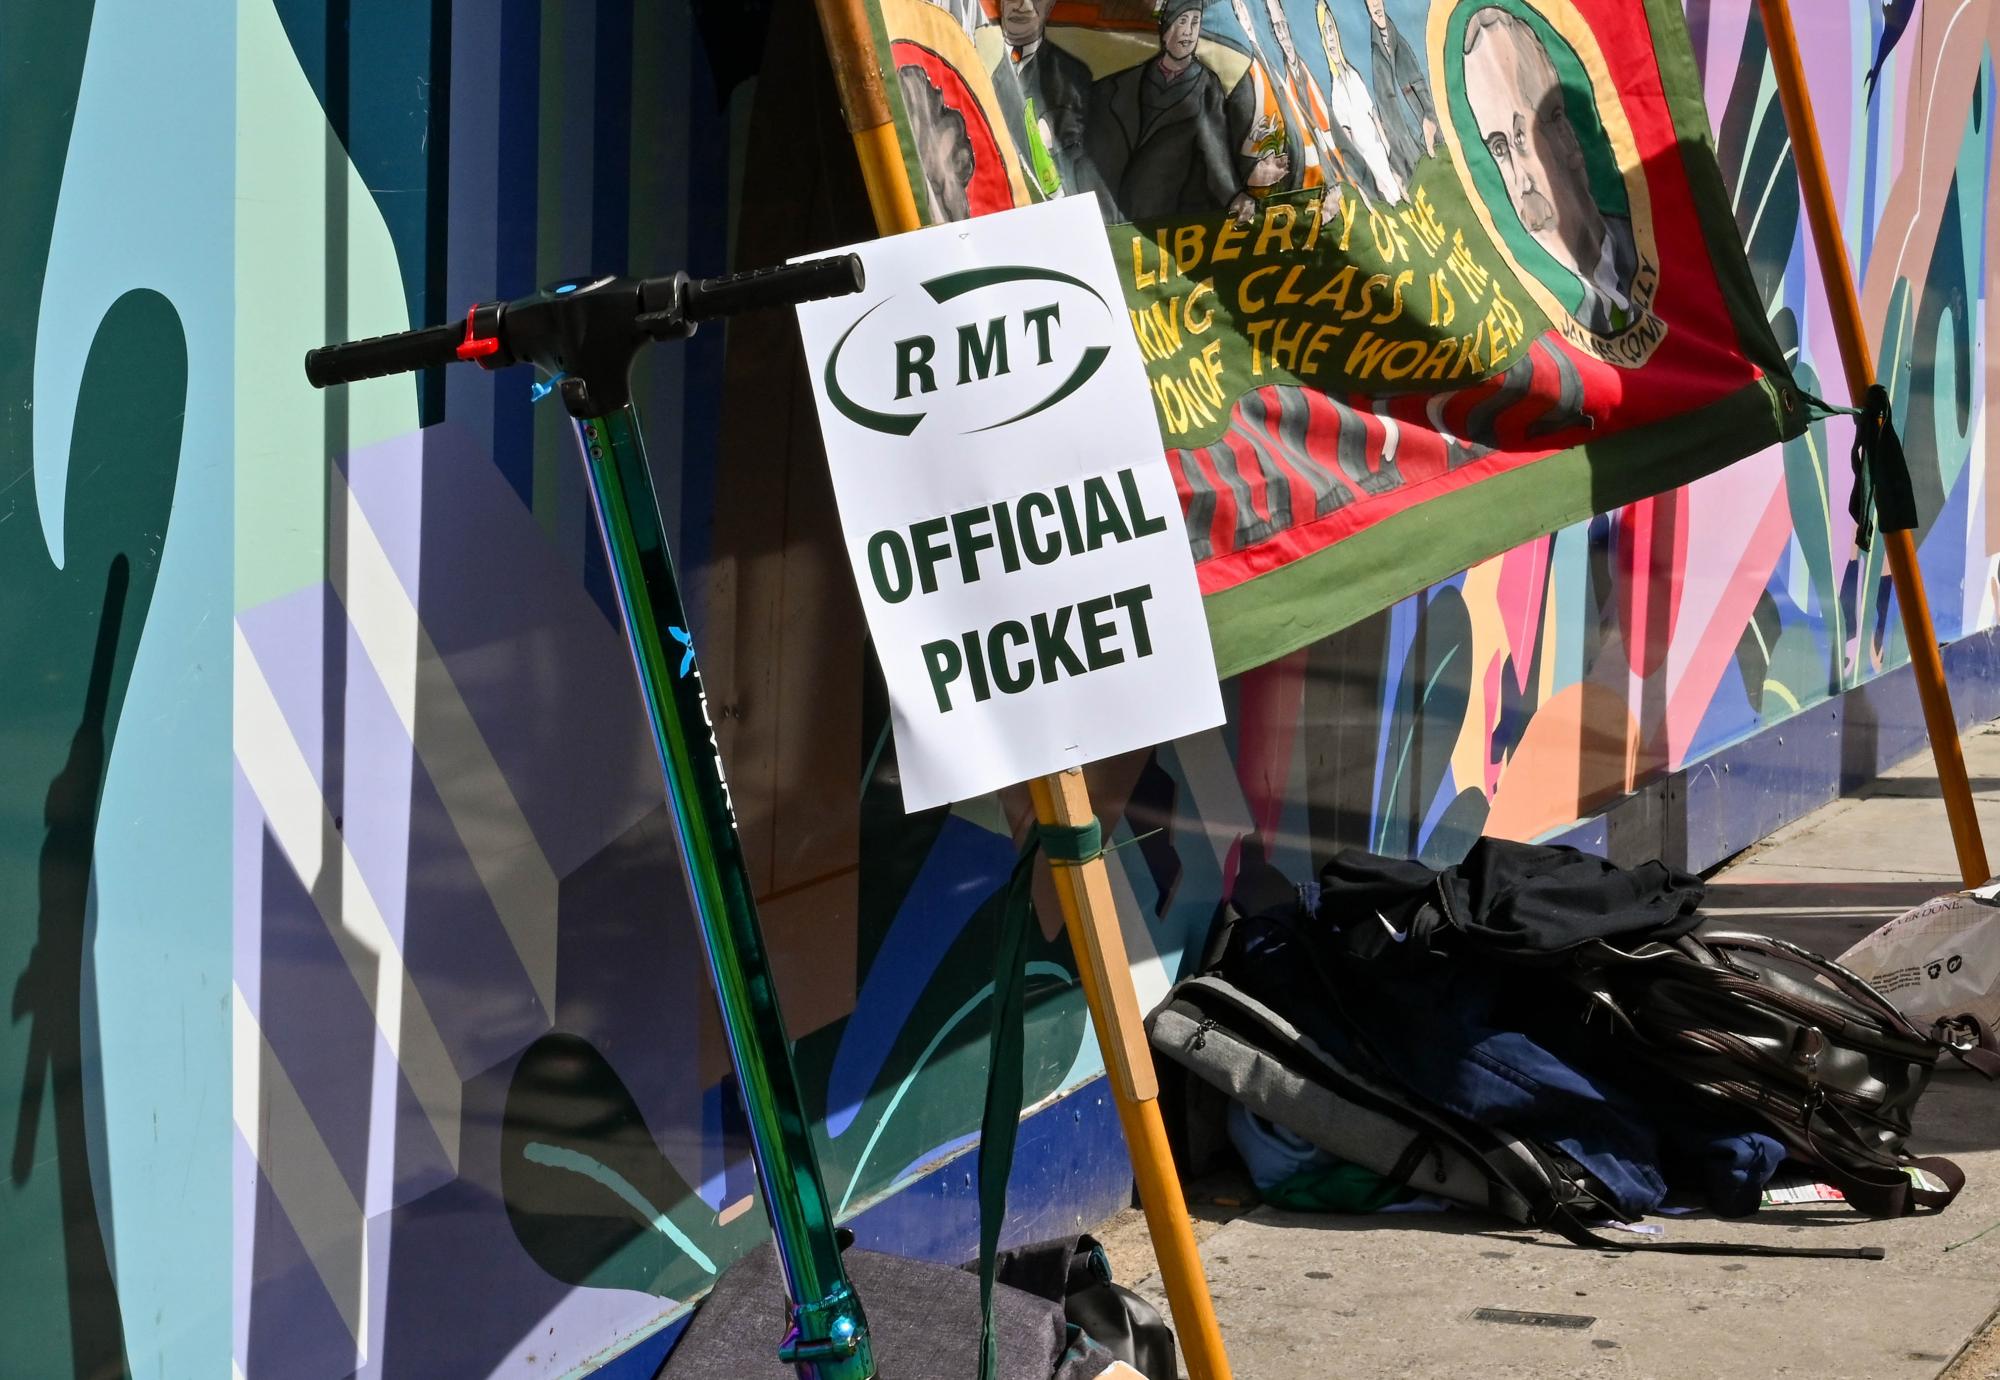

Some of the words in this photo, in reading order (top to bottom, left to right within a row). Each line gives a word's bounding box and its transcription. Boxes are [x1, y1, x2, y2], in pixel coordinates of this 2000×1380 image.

[1132, 194, 1357, 290] LIBERTY
[1369, 206, 1409, 263] OF
[1399, 184, 1446, 258] THE
[1129, 277, 1215, 366] KING
[1237, 264, 1414, 325] CLASS
[1429, 268, 1456, 327] IS
[1446, 228, 1490, 304] THE
[1246, 317, 1344, 377] THE
[1343, 279, 1525, 382] WORKERS
[1560, 311, 1625, 365] JAMES
[892, 301, 1062, 401] RMT
[866, 467, 1168, 605] OFFICIAL
[920, 583, 1154, 714] PICKET
